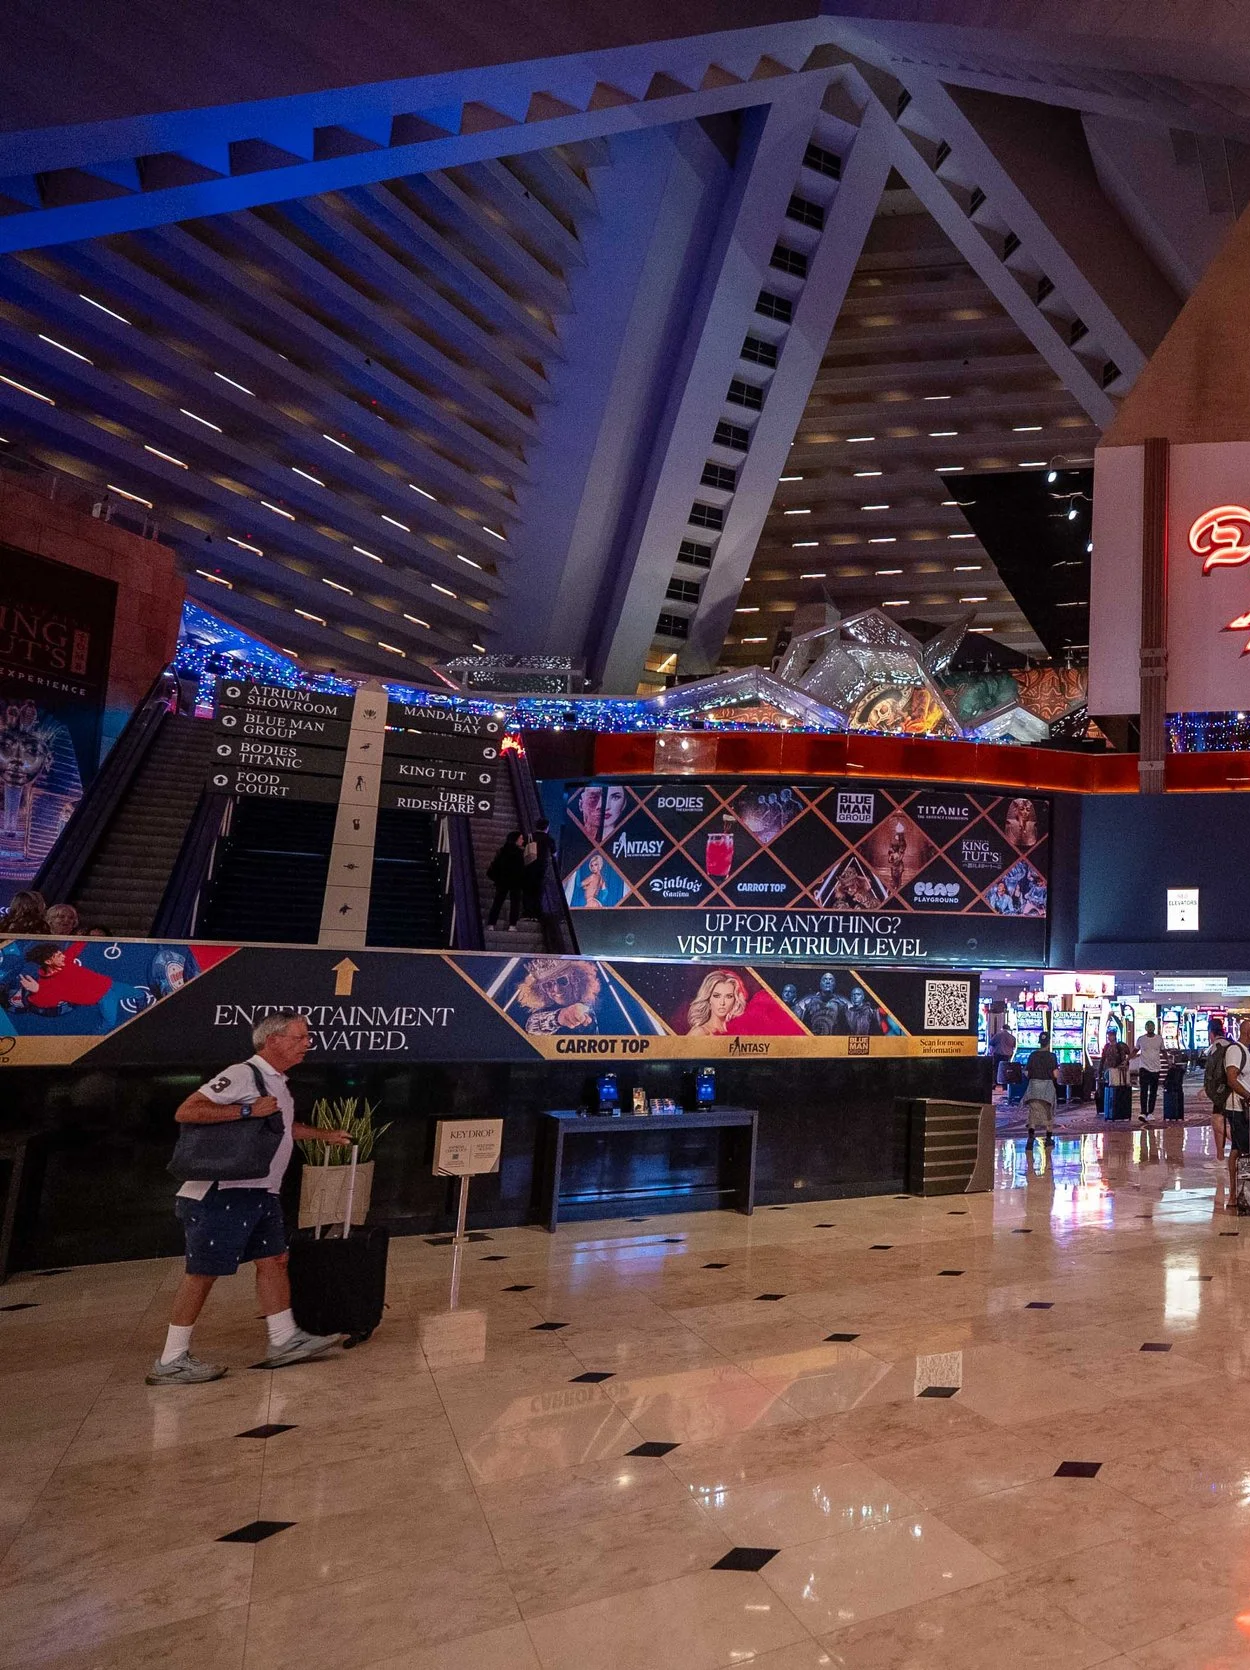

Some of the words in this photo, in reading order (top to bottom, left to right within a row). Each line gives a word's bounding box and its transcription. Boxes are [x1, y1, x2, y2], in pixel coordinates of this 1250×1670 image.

[0, 605, 68, 648] ING
[249, 685, 310, 701] ATRIUM
[247, 695, 338, 716] SHOWROOM
[245, 713, 286, 728] BLUE
[290, 719, 325, 732] MAN
[404, 706, 482, 725] MANDALAY
[243, 724, 297, 739] GROUP
[454, 723, 480, 735] BAY
[240, 743, 297, 758] BODIES
[239, 753, 302, 769] TITANIC
[237, 772, 280, 785] FOOD
[399, 765, 435, 778] KING
[439, 769, 467, 781] TUT
[235, 783, 289, 796] COURT
[397, 797, 475, 814] RIDESHARE
[440, 792, 475, 805] UBER
[657, 796, 704, 808] BODIES
[839, 795, 872, 804] BLUE
[838, 804, 871, 814] MAN
[917, 805, 969, 816] TITANIC
[838, 813, 871, 822] GROUP
[612, 831, 665, 858] FANTASY
[962, 841, 990, 851] KING
[961, 850, 999, 862] TUT'S
[649, 875, 702, 893] Diablo's
[737, 882, 769, 893] CARROT
[770, 883, 787, 893] TOP
[914, 881, 960, 897] PLAY
[913, 896, 959, 904] PLAYGROUND
[705, 914, 733, 932] UP
[735, 914, 777, 932] FOR
[780, 915, 902, 935] ANYTHING?
[677, 935, 727, 954] VISIT
[731, 936, 775, 955] THE
[778, 936, 861, 956] ATRIUM
[864, 938, 927, 957] LEVEL
[213, 1005, 455, 1027] ENTRTAINMENT
[306, 1031, 409, 1050] EVATED.
[556, 1038, 617, 1054] CARROT
[621, 1039, 650, 1054] TOP
[729, 1036, 770, 1056] FANTASY
[920, 1039, 936, 1047] Scan
[937, 1039, 946, 1047] for
[922, 1046, 961, 1054] information
[450, 1130, 468, 1139] KEY
[469, 1129, 494, 1137] DROP
